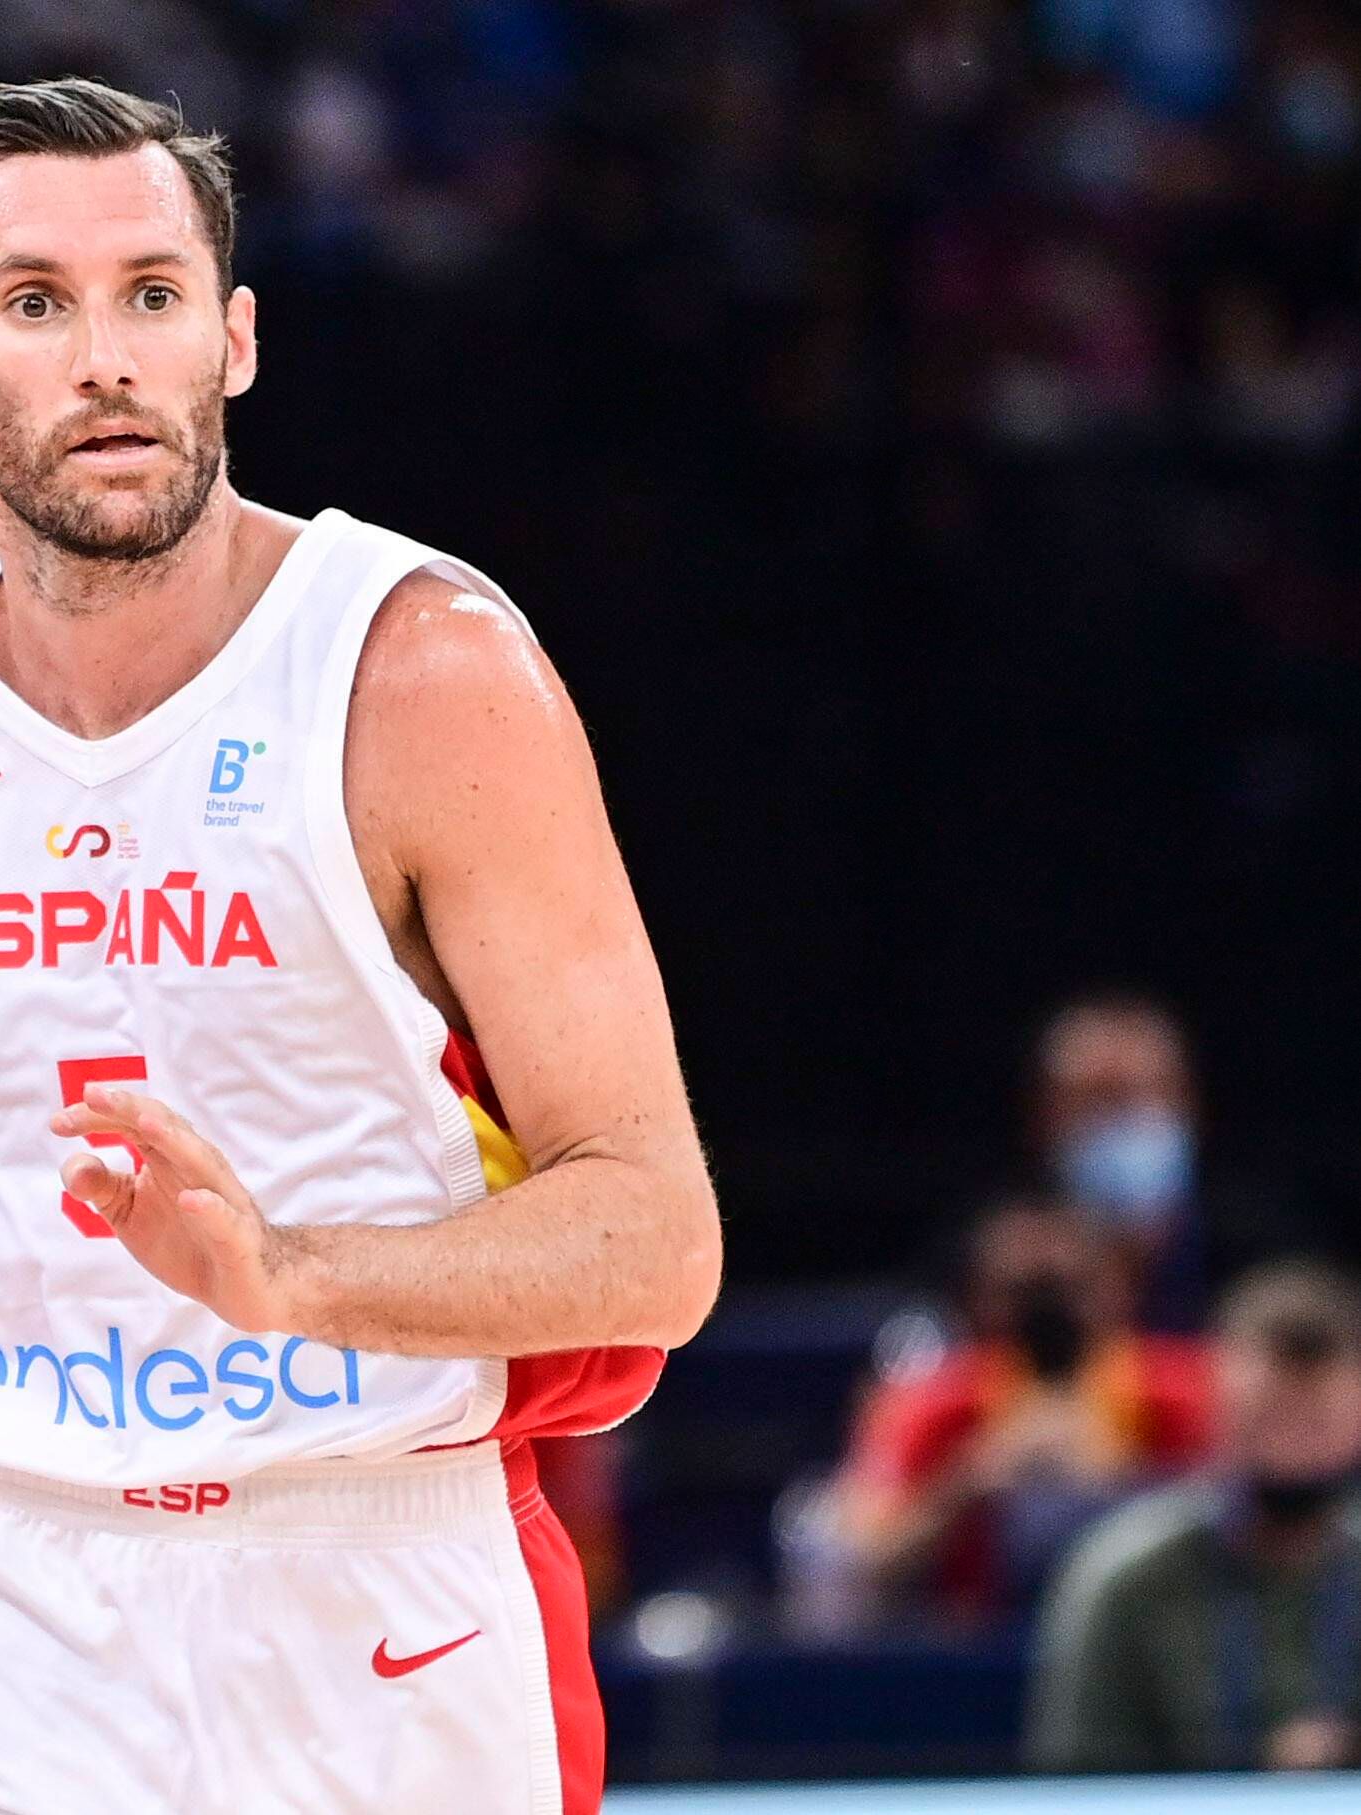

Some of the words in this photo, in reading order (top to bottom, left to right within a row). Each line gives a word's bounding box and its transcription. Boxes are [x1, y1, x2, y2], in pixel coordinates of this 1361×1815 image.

[206, 799, 226, 812] the
[228, 801, 265, 814] travel
[203, 813, 240, 827] brand
[123, 1483, 231, 1516] ESP
